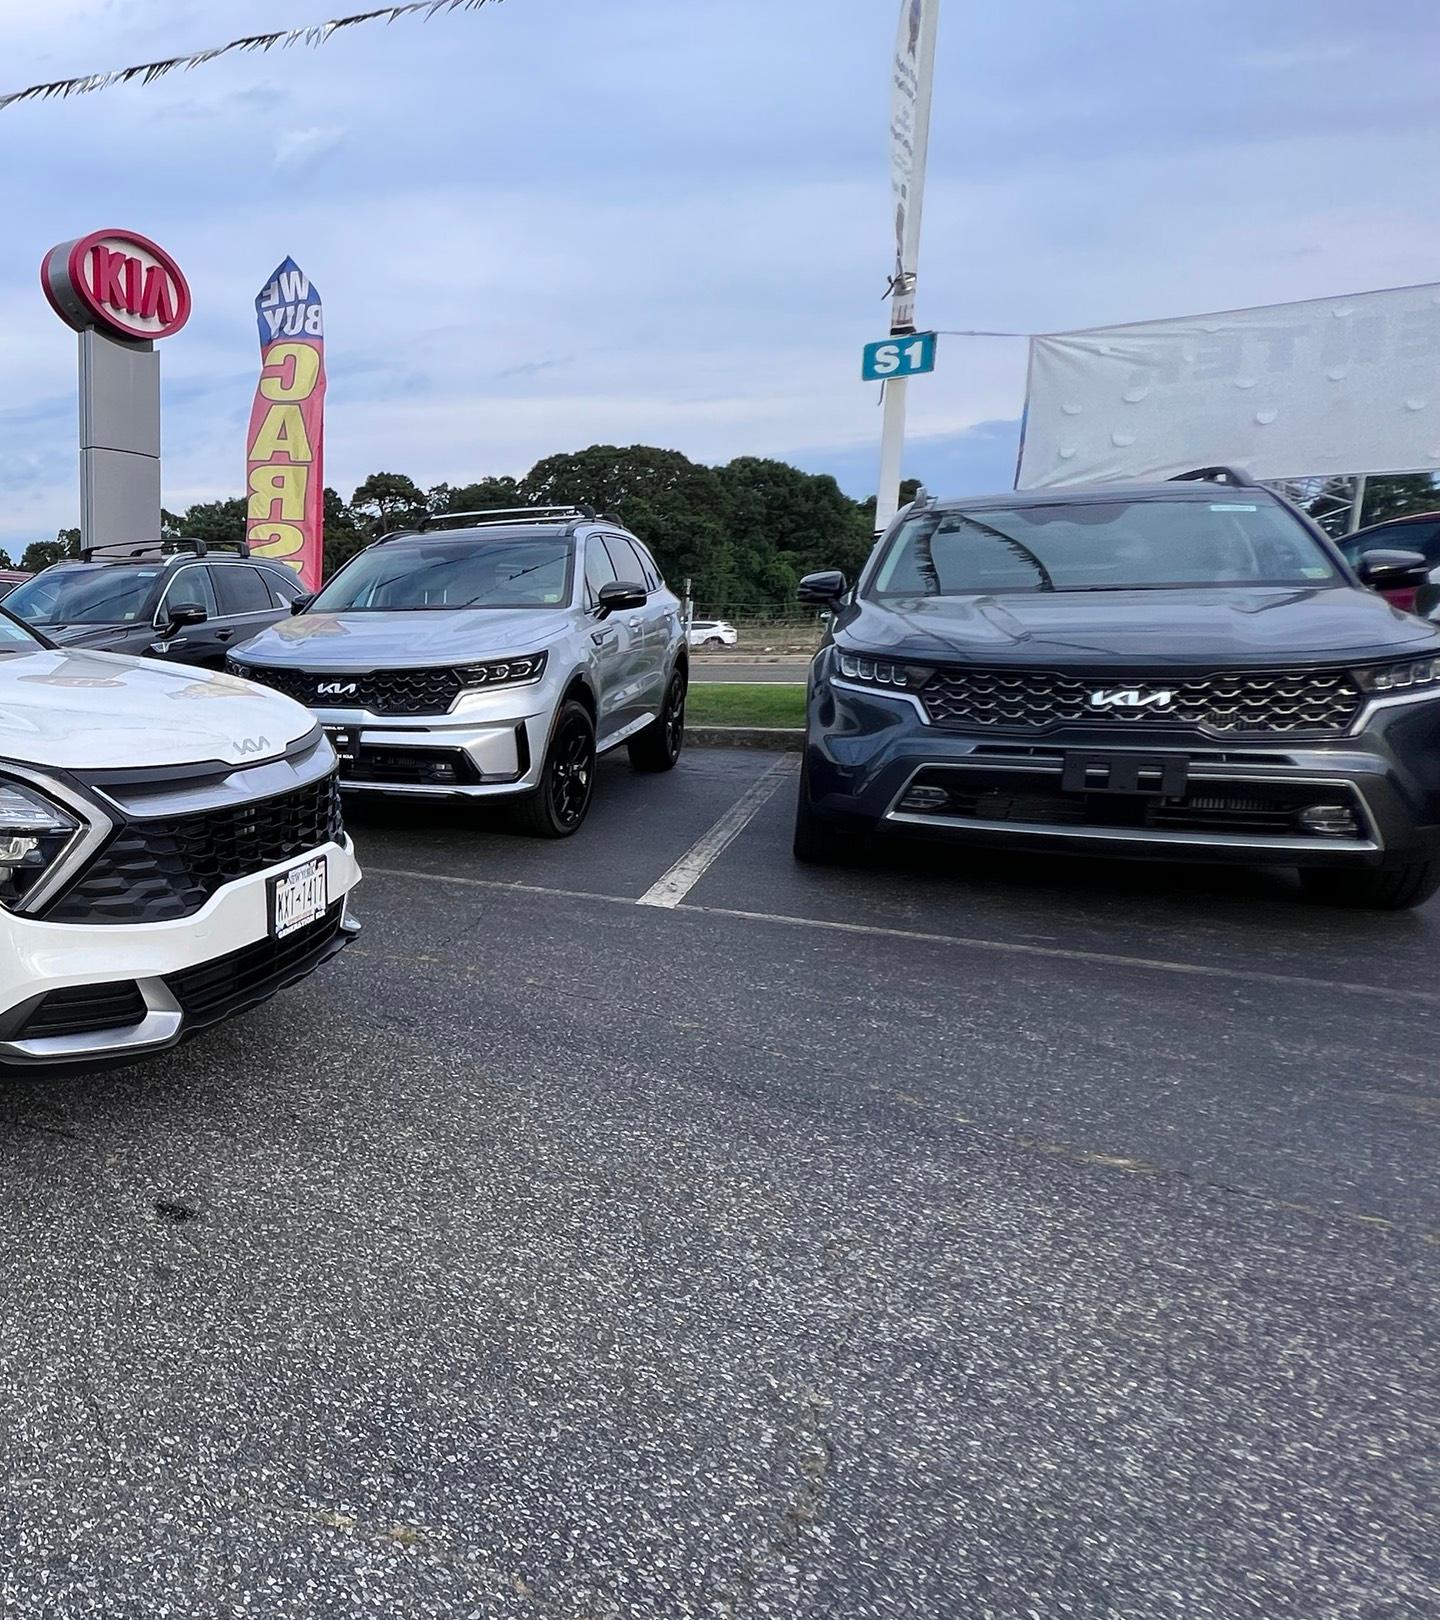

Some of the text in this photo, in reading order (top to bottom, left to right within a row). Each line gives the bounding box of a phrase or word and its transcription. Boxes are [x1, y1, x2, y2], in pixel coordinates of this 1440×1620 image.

[91, 245, 175, 324] KIA
[873, 341, 923, 374] S1
[317, 682, 357, 694] KIA
[1091, 690, 1172, 706] KIA
[232, 735, 271, 756] KIA
